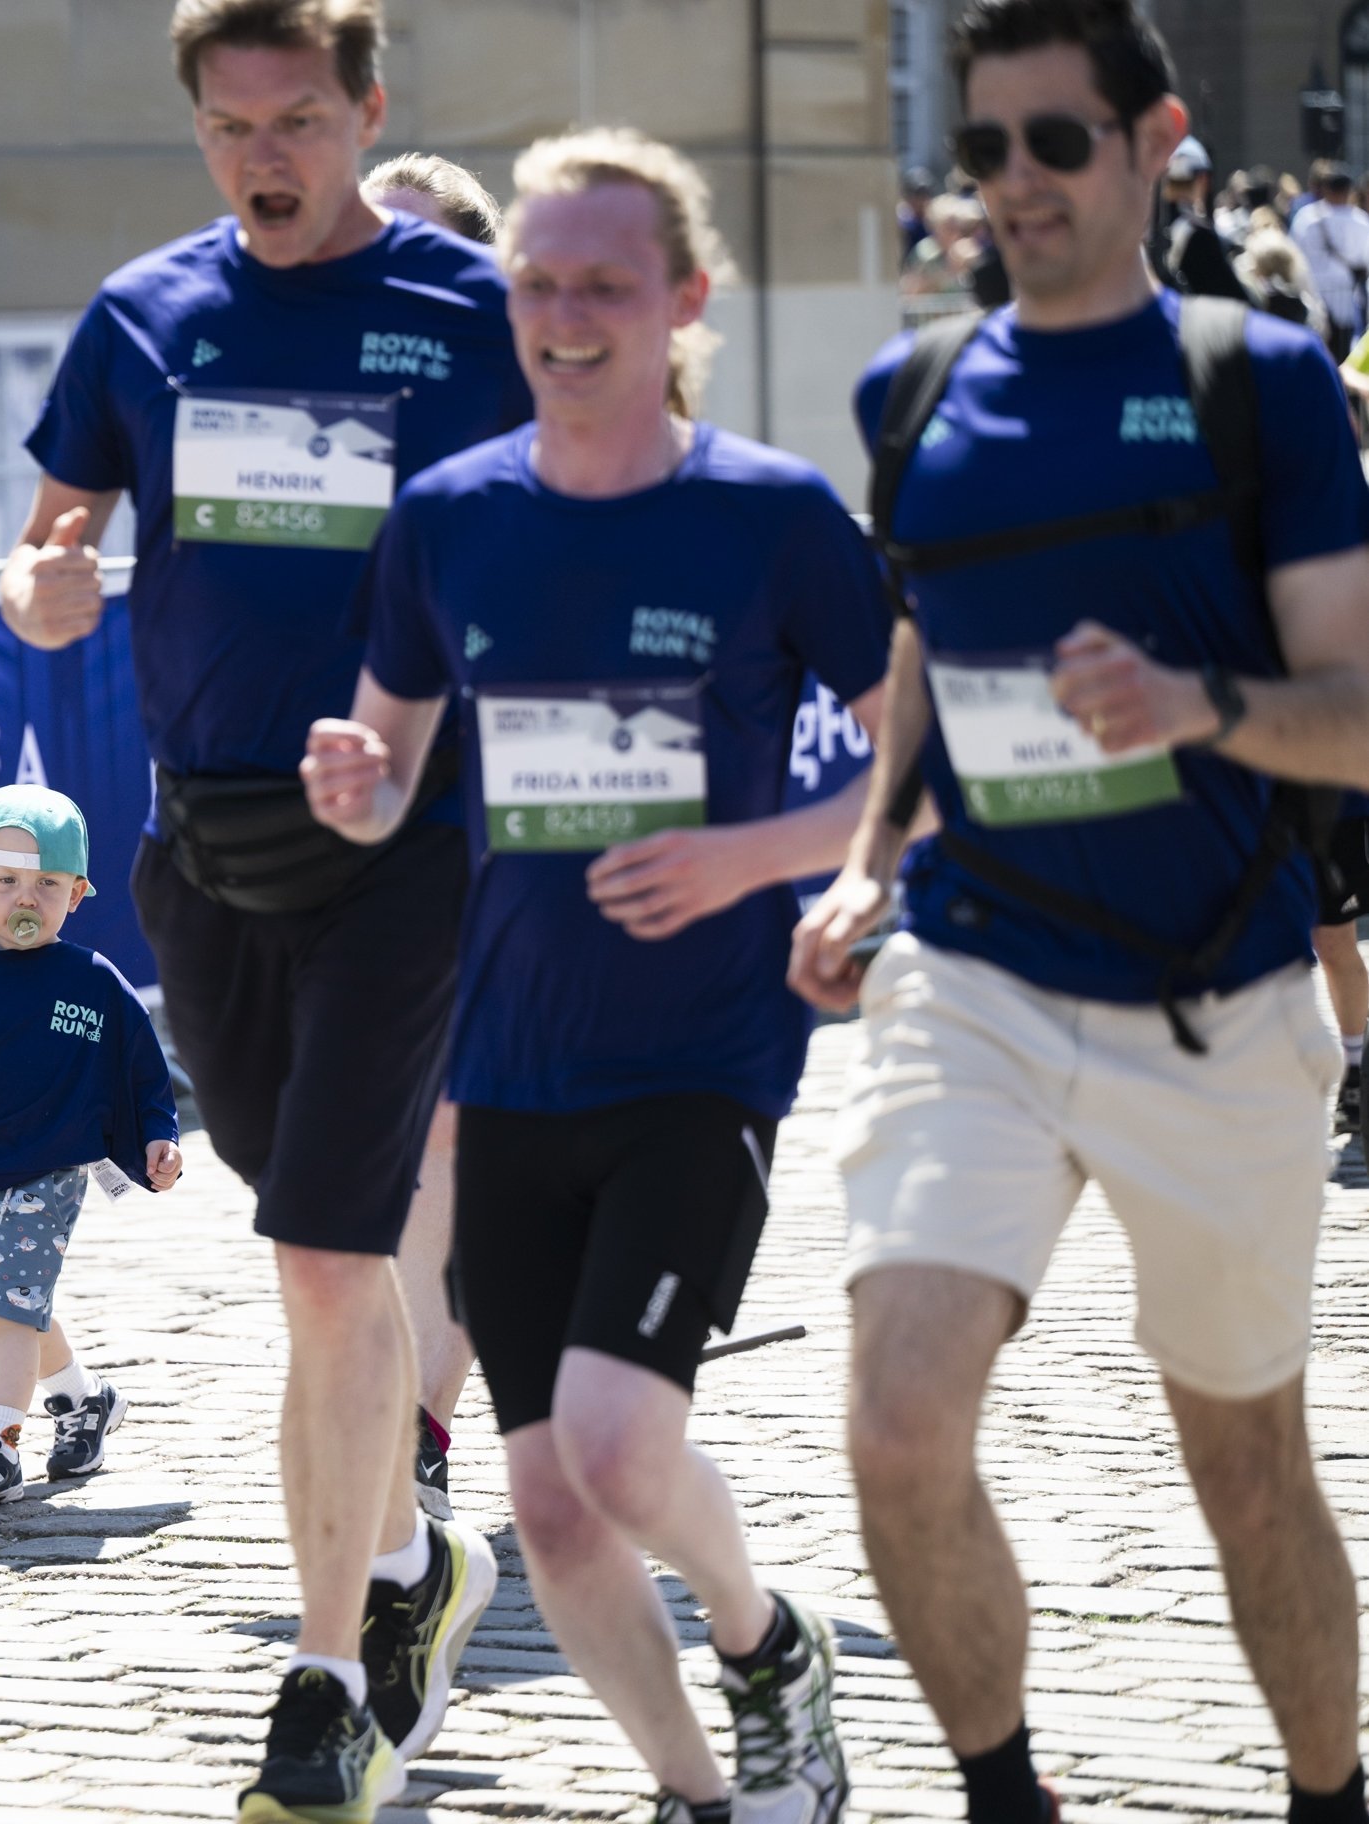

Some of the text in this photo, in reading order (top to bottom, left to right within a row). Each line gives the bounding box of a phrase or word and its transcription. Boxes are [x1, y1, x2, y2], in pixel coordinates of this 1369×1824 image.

[362, 331, 452, 361] ROYAL
[360, 353, 419, 375] RUN
[1124, 396, 1194, 419] ROY
[1120, 418, 1197, 443] RUN
[237, 471, 325, 491] HENRIK
[195, 501, 324, 532] C 82456
[633, 606, 716, 643] ROYAL
[629, 632, 686, 656] RUN
[1012, 740, 1072, 763] NICK
[512, 770, 671, 792] FRIDA KREBS
[505, 811, 527, 838] C
[50, 1015, 87, 1038] RUN
[110, 1182, 128, 1194] ROYAL
[113, 1189, 126, 1198] RUN
